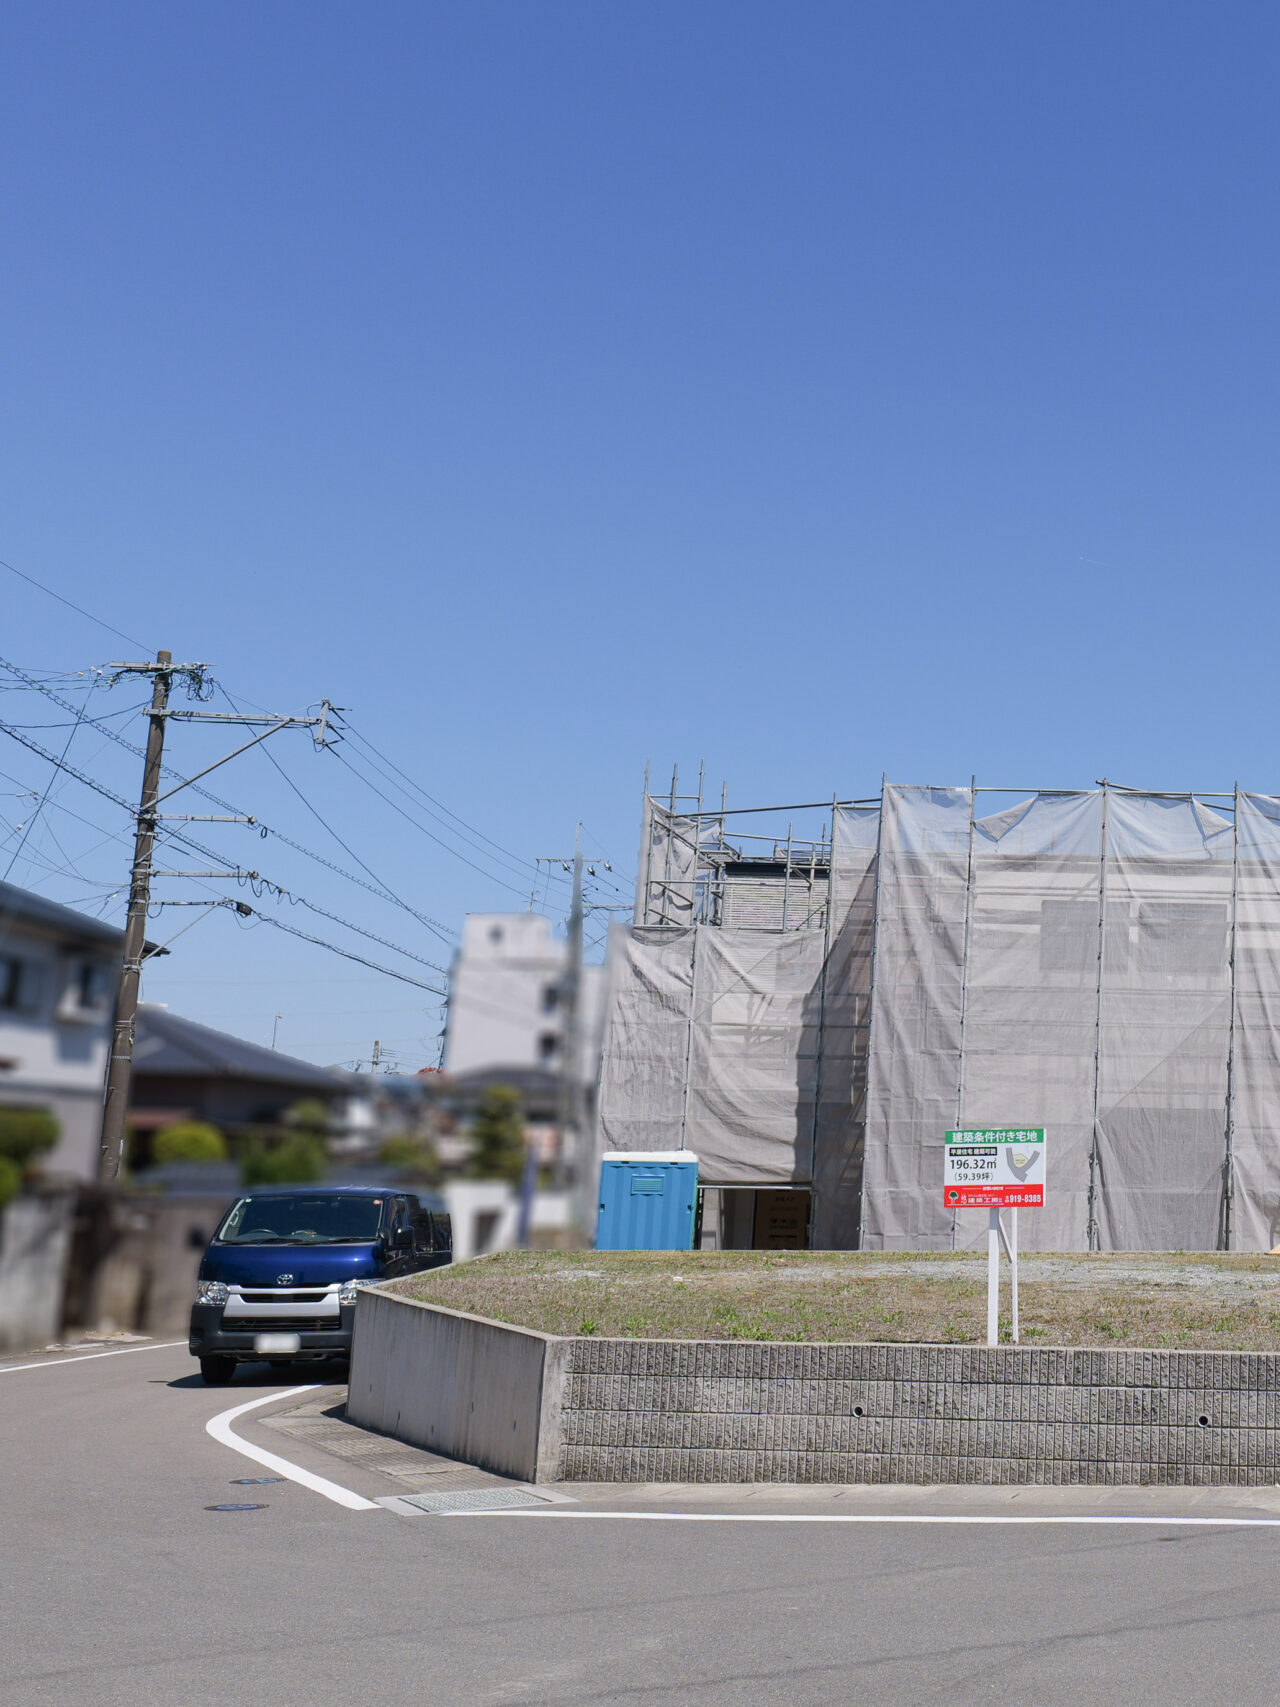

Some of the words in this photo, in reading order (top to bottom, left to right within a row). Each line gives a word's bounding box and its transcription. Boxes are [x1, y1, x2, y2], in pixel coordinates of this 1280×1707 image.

[952, 1131, 1038, 1143] 建築条件付き宅地
